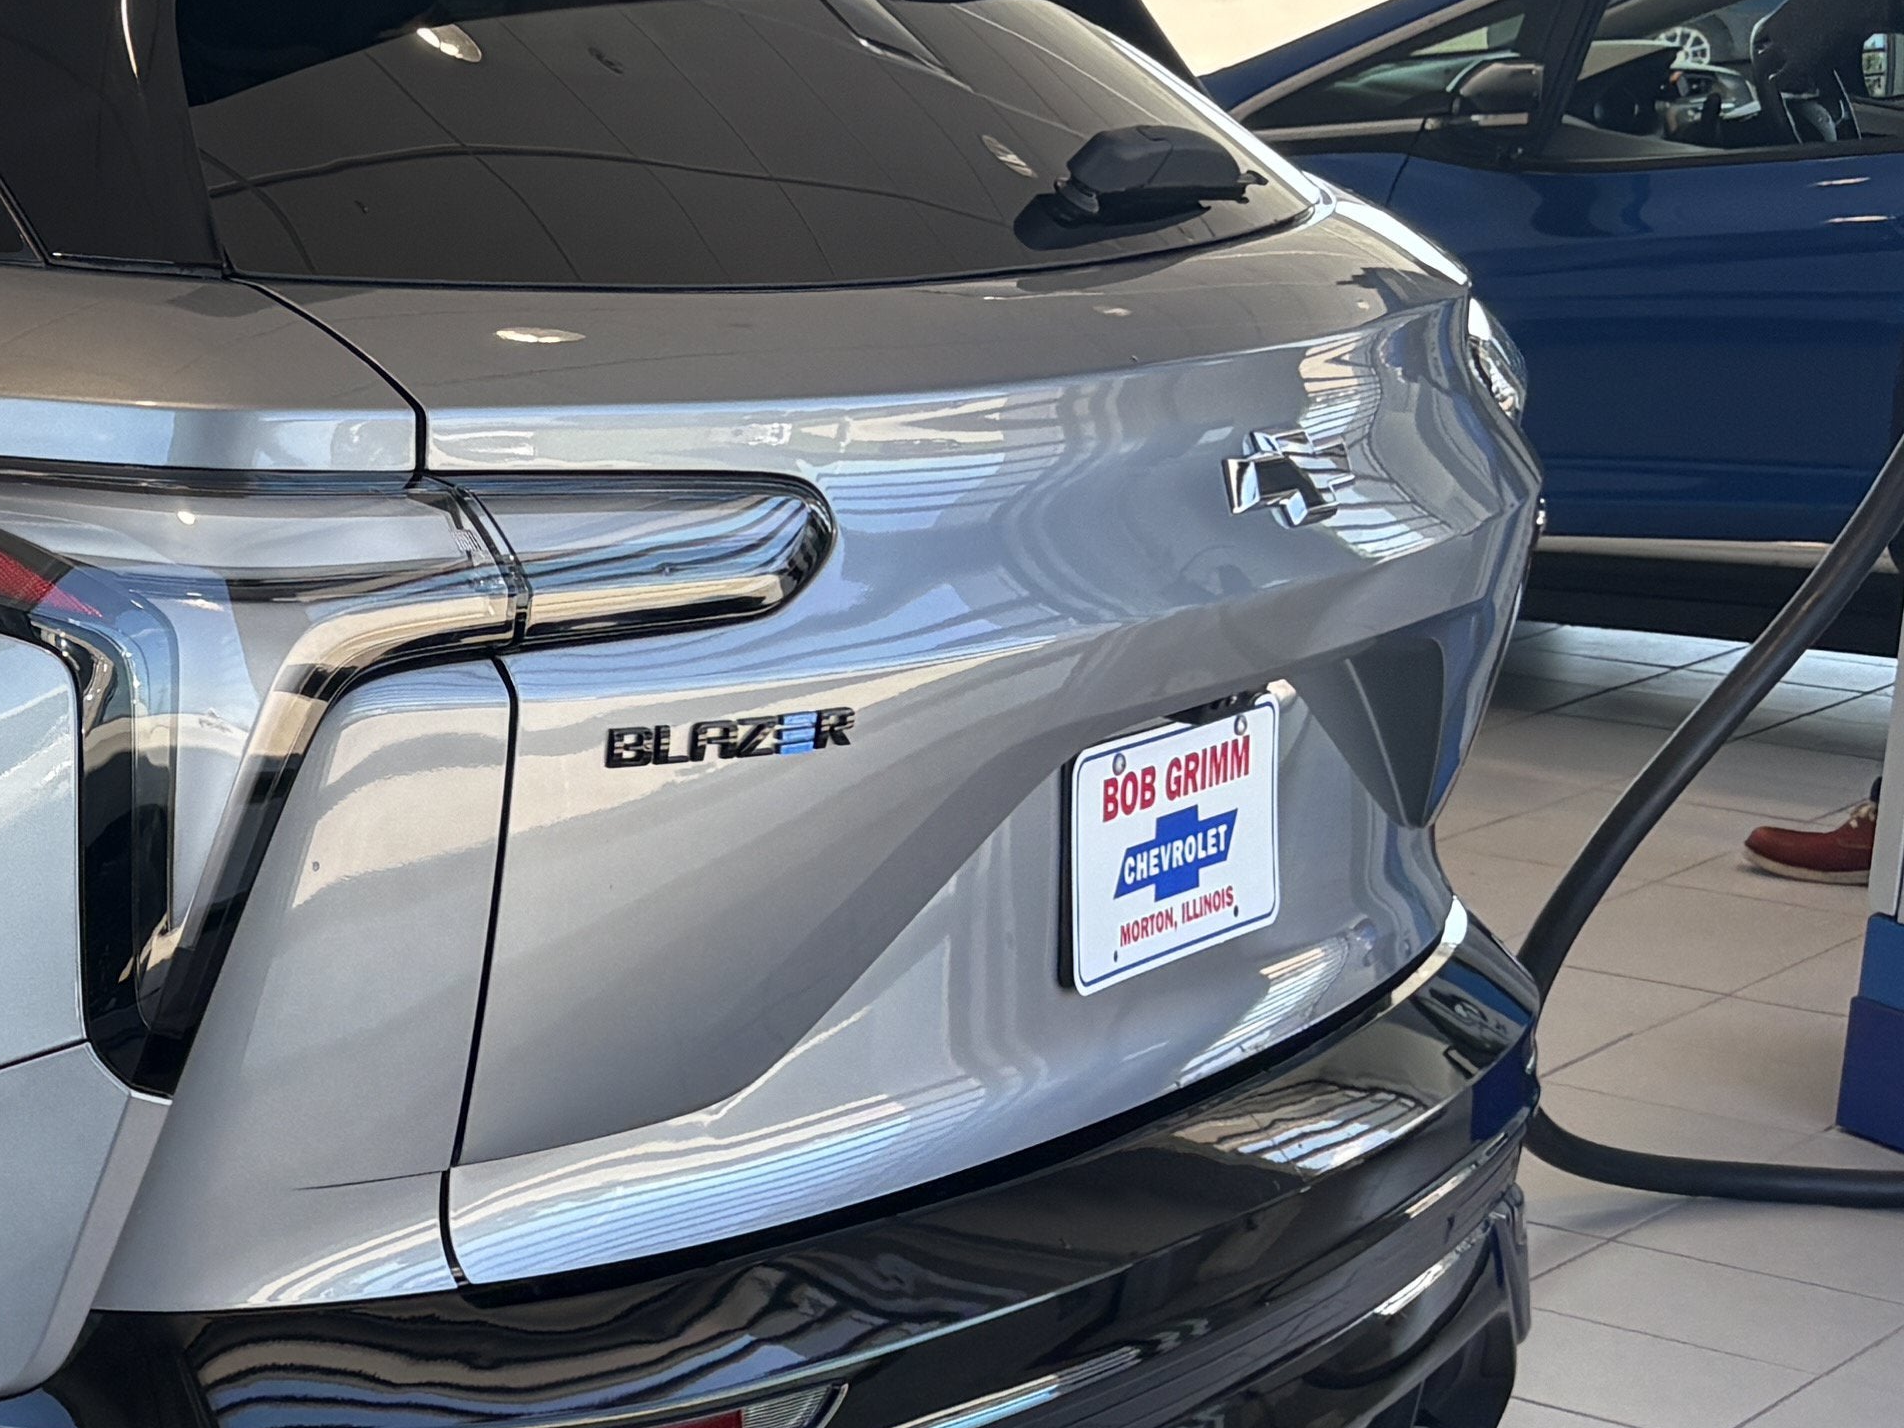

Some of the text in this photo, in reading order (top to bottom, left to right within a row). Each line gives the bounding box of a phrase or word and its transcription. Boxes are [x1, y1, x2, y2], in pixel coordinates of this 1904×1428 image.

[605, 706, 856, 769] BLAZER
[1103, 735, 1250, 823] BOB GRIMM
[1123, 824, 1228, 885] CHEVROLET
[1120, 885, 1234, 947] MORTON, ILLINOIS
